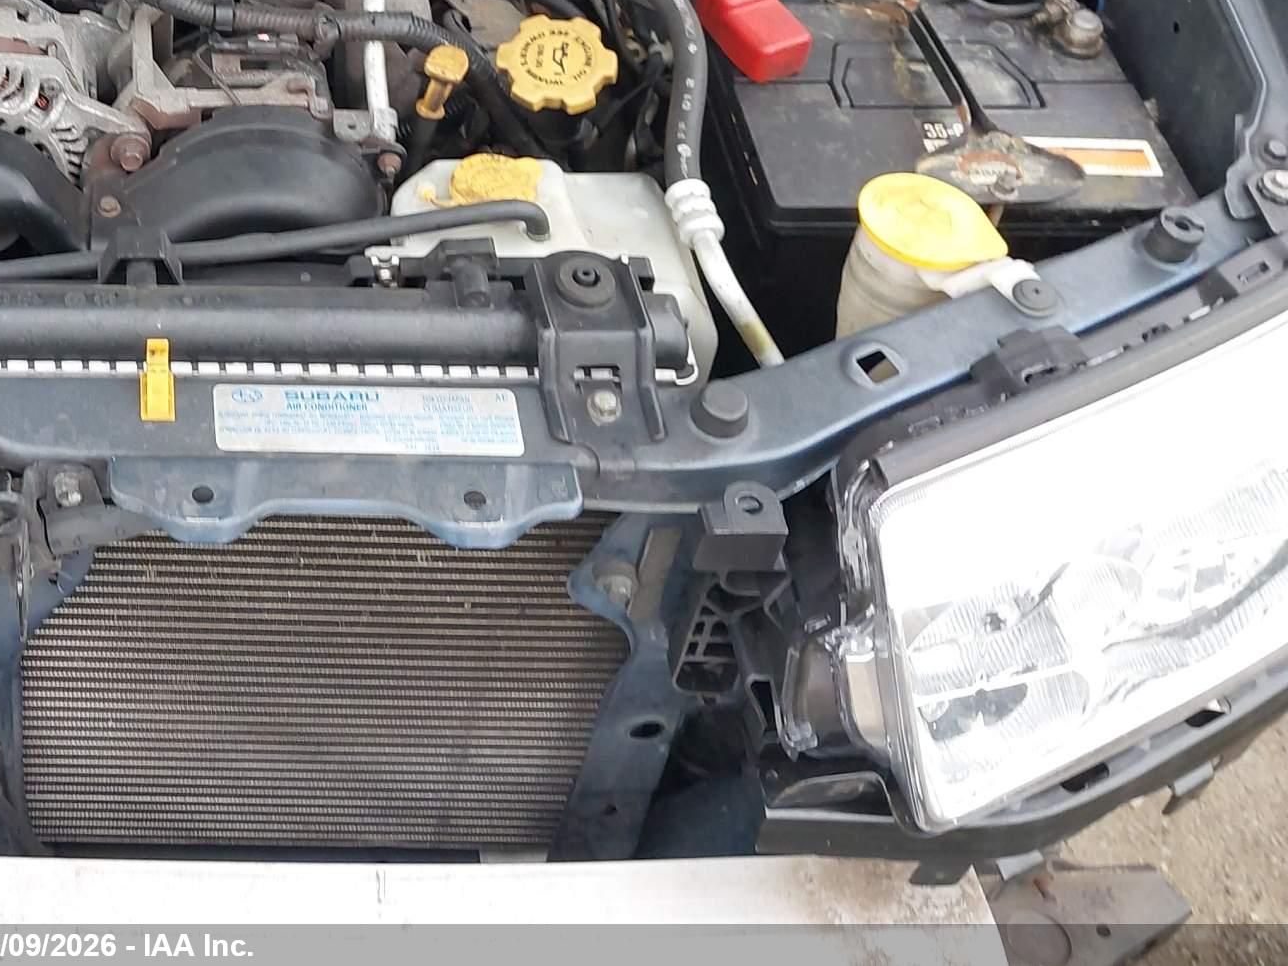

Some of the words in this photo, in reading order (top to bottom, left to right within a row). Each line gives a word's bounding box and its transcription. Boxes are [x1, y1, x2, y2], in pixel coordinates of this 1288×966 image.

[284, 390, 380, 402] SUBARU
[286, 402, 302, 411] AIR
[304, 402, 368, 412] CONDITIONER
